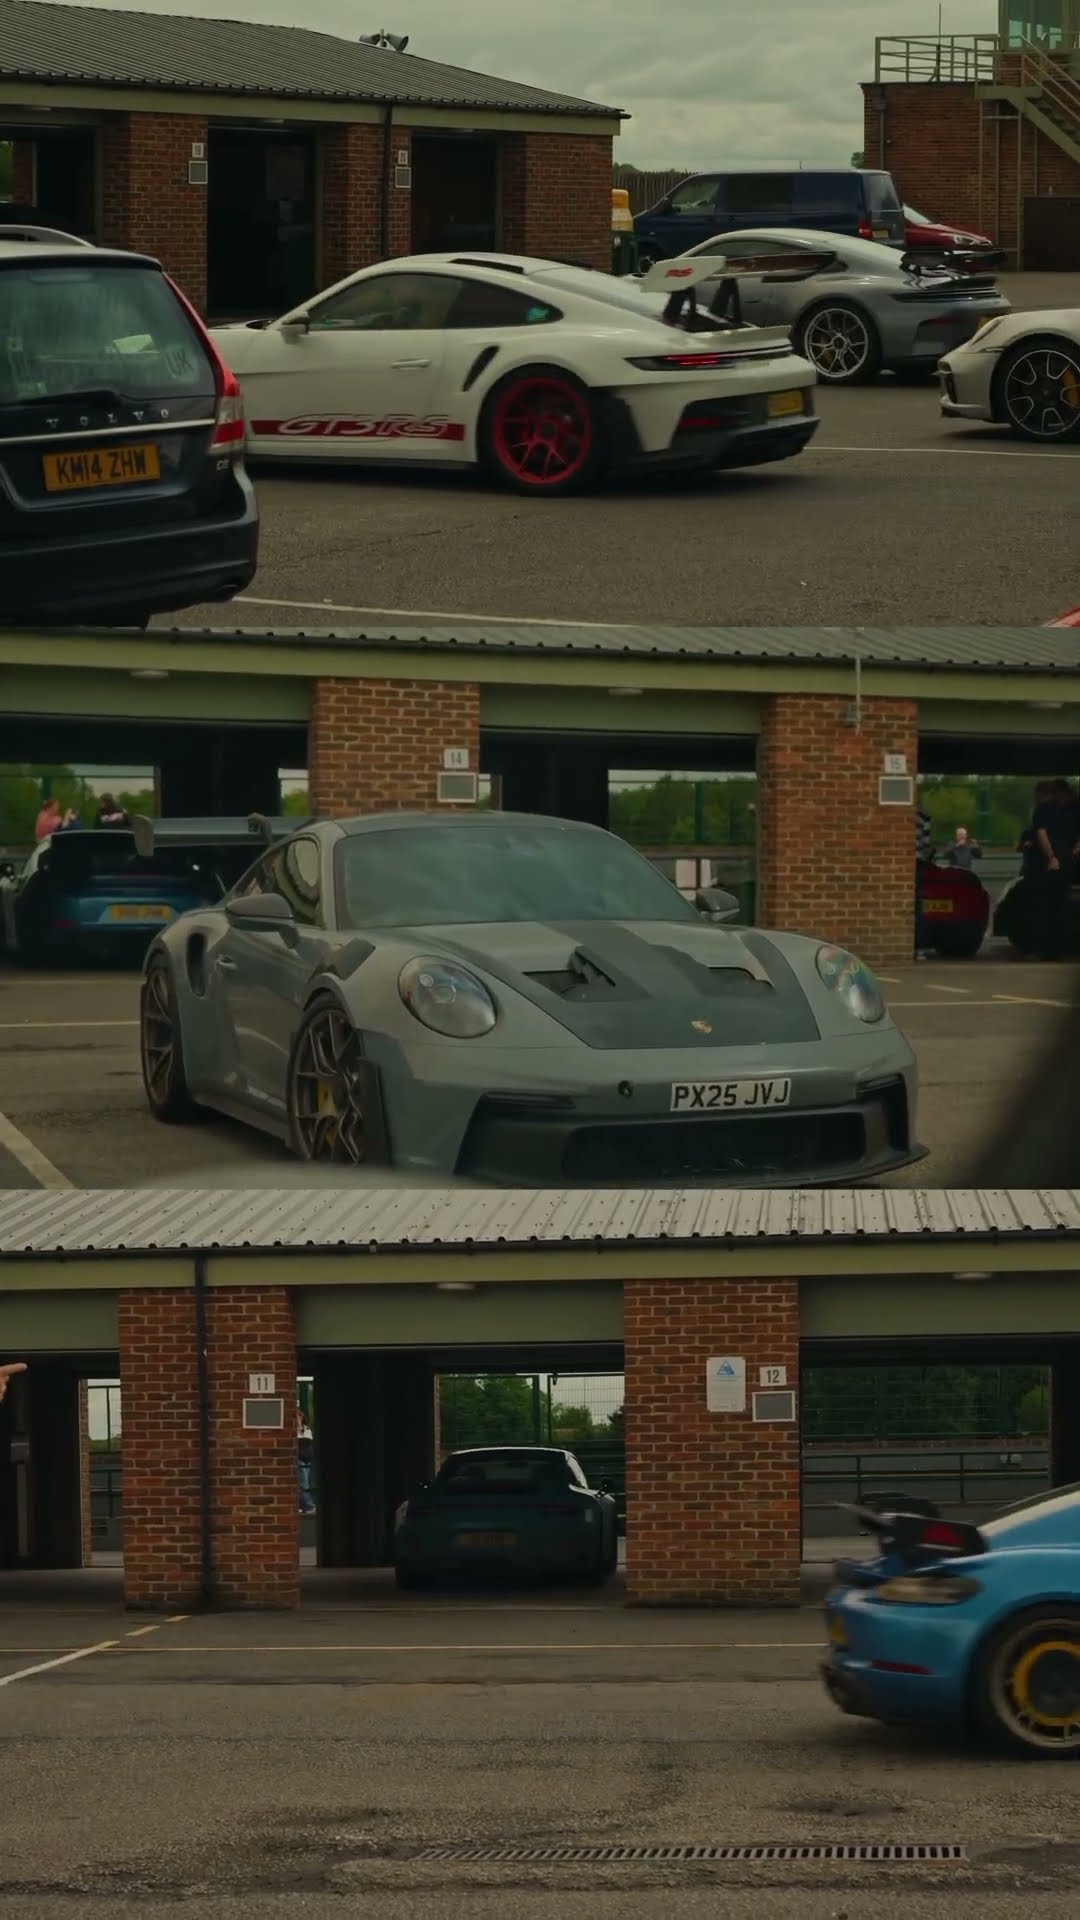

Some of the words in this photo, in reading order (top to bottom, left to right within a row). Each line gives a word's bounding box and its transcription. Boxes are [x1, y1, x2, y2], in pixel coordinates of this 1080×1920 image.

[46, 409, 169, 428] VOLVO
[56, 453, 102, 484] KM14
[109, 449, 147, 478] ZHW
[450, 751, 462, 765] 14
[674, 1084, 738, 1109] PX25
[743, 1080, 789, 1106] JVJ
[257, 1376, 268, 1391] 11
[766, 1369, 780, 1384] 12
